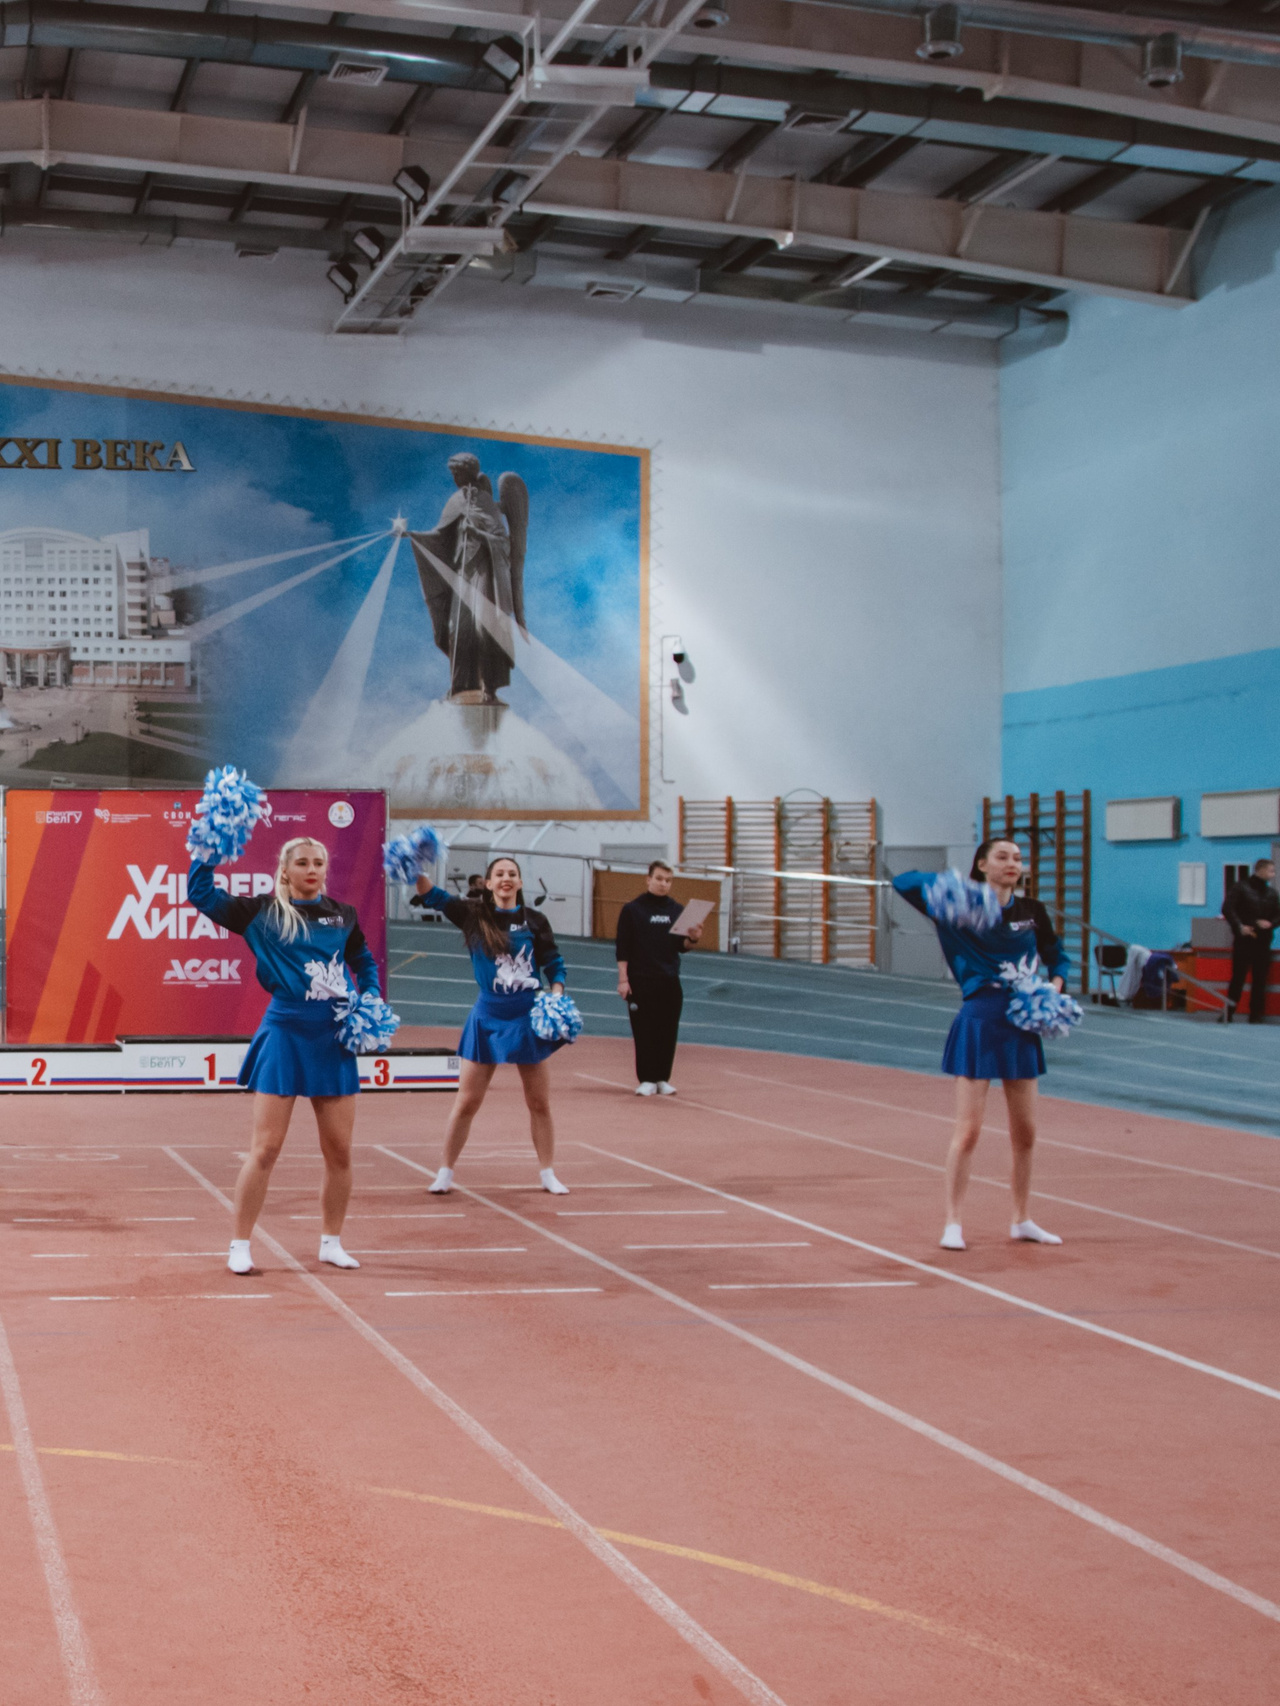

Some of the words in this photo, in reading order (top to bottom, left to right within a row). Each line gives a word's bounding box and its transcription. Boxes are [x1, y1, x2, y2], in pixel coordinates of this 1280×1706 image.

[72, 438, 197, 472] ВЕКА
[163, 958, 241, 980] АССК
[31, 1057, 47, 1086] 2
[203, 1053, 216, 1081] 1
[374, 1058, 390, 1087] 3
